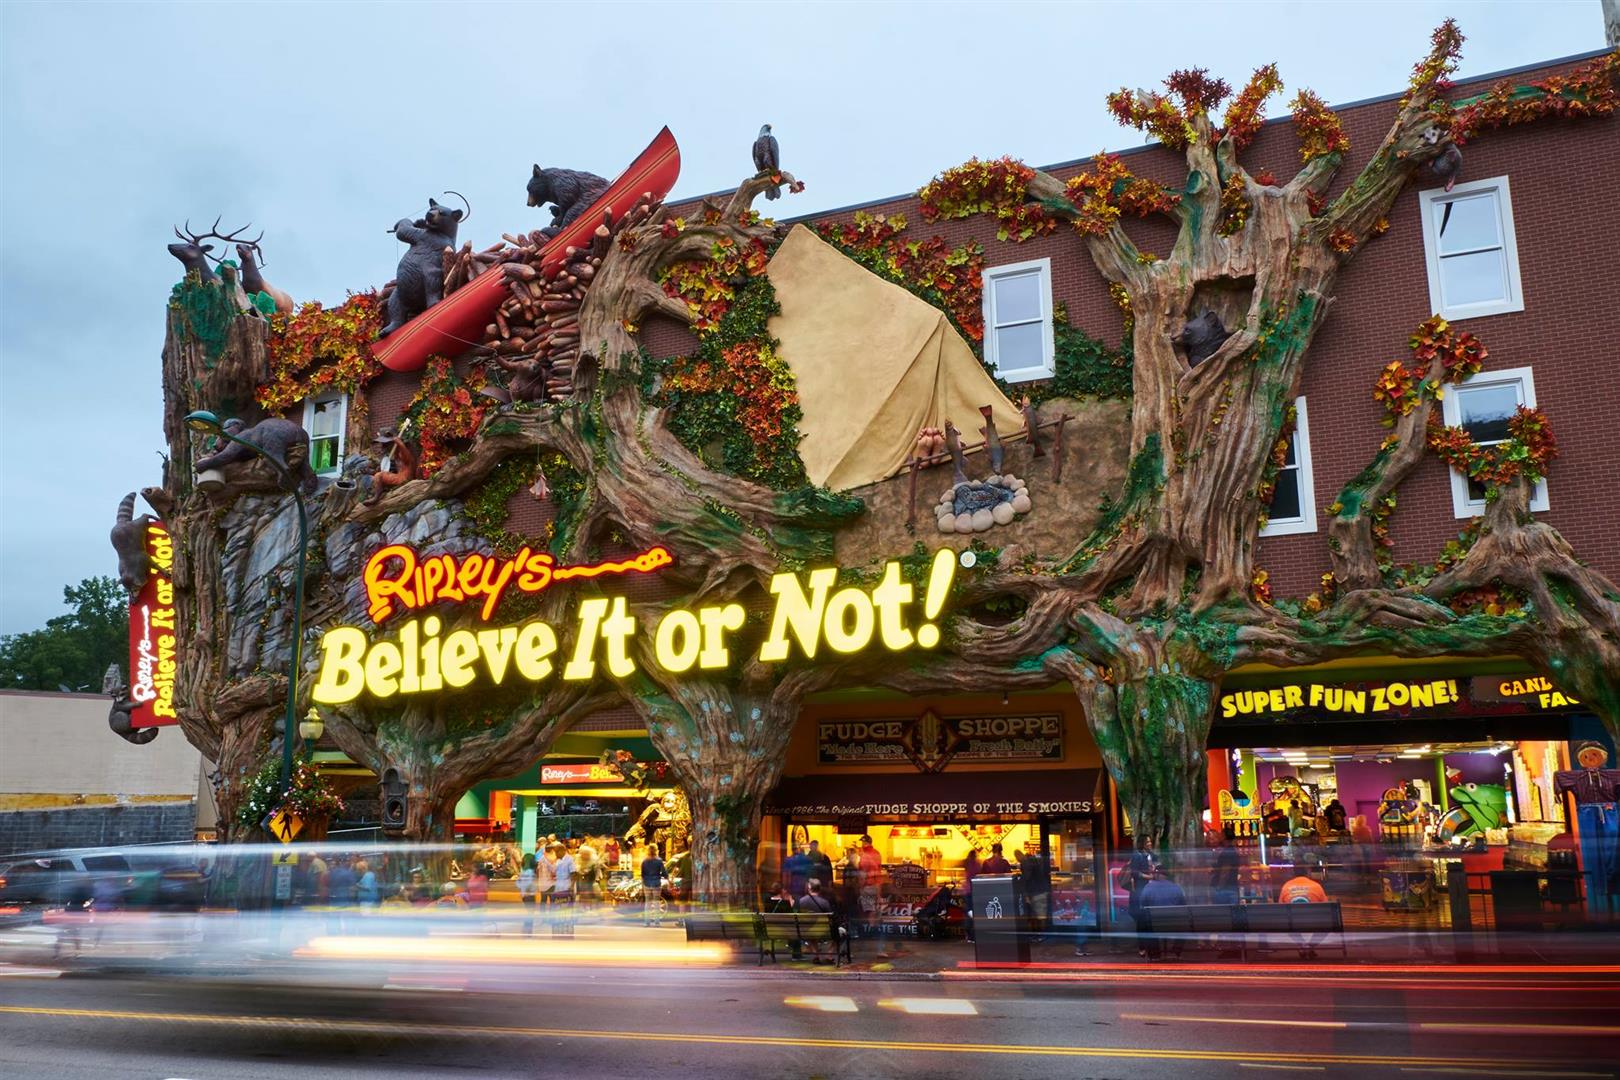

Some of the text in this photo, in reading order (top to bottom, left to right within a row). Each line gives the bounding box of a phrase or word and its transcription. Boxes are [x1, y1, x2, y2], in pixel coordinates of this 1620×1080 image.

[156, 578, 174, 604] or
[151, 608, 175, 631] It
[311, 548, 956, 704] Believe It or Not!
[1220, 679, 1460, 718] SUPER FUN ZONE!
[820, 717, 1059, 740] FUDGE SHOPPE
[831, 805, 864, 816] Original
[866, 804, 908, 814] FUDGE
[912, 803, 967, 814] SHOPPE
[973, 803, 990, 813] OF
[996, 802, 1023, 813] THE
[1027, 801, 1092, 813] SMOKIES
